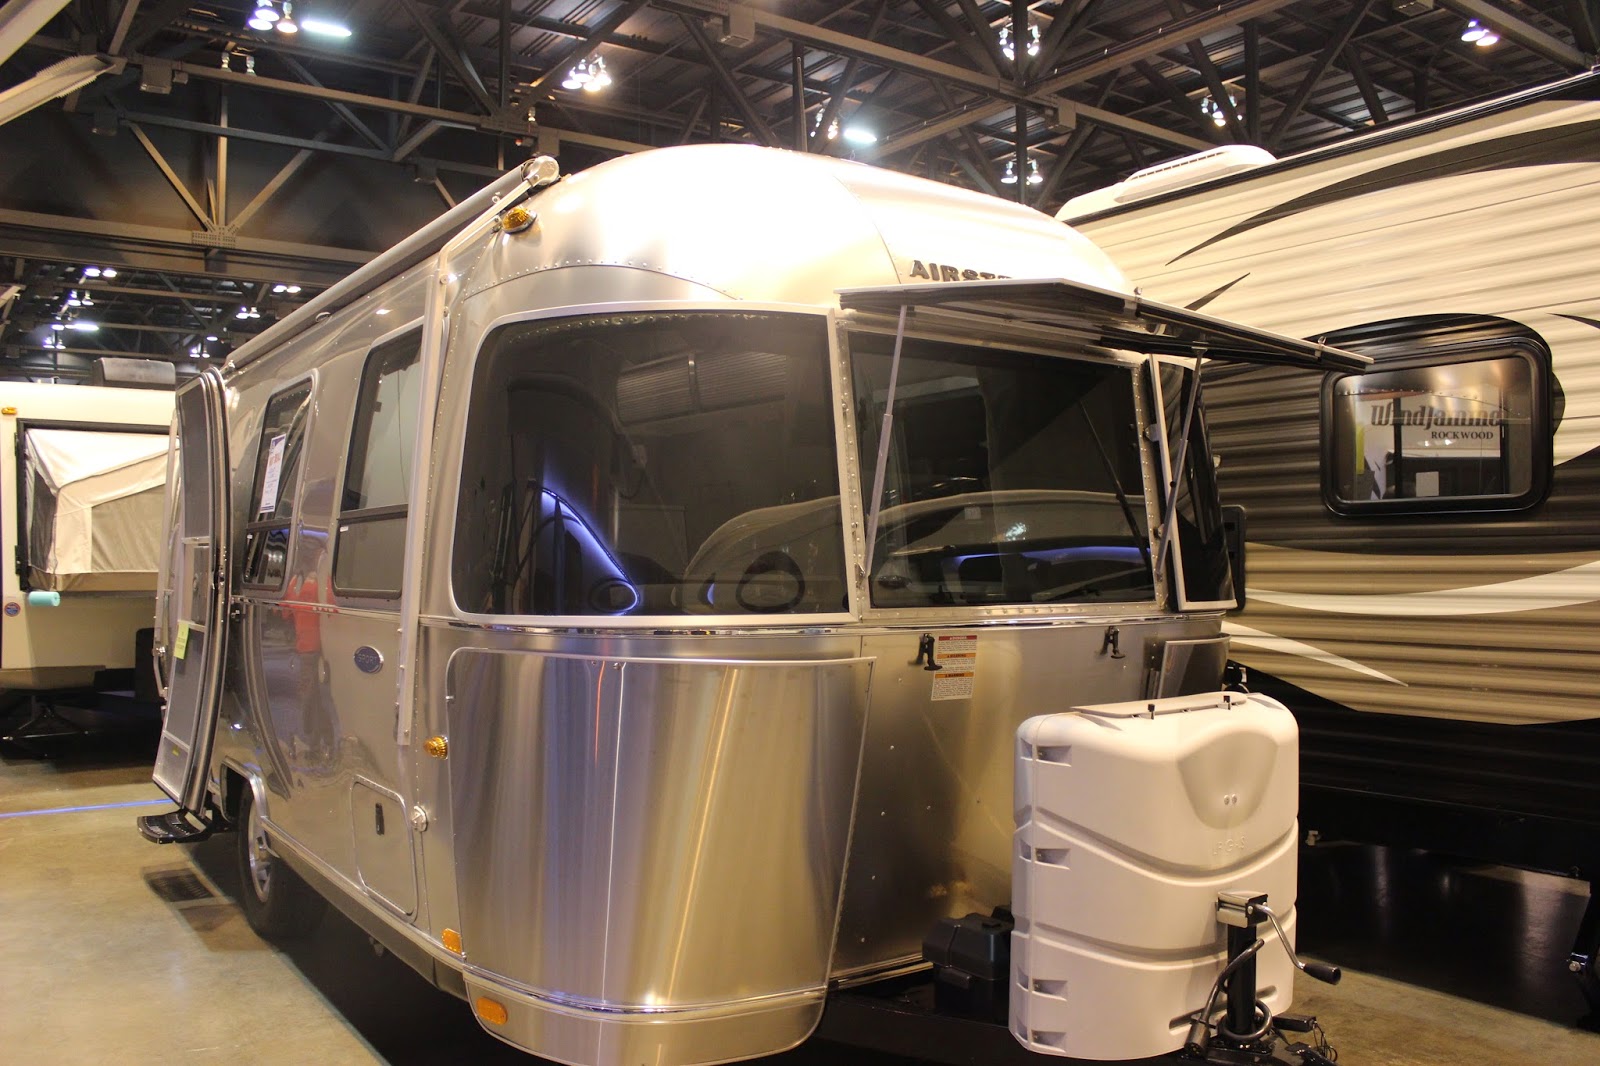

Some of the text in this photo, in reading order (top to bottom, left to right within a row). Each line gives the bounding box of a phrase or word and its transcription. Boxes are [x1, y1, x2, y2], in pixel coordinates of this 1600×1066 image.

[910, 260, 1011, 282] AIRST
[1431, 431, 1493, 440] ROCKWOOD
[357, 653, 376, 664] SPORT
